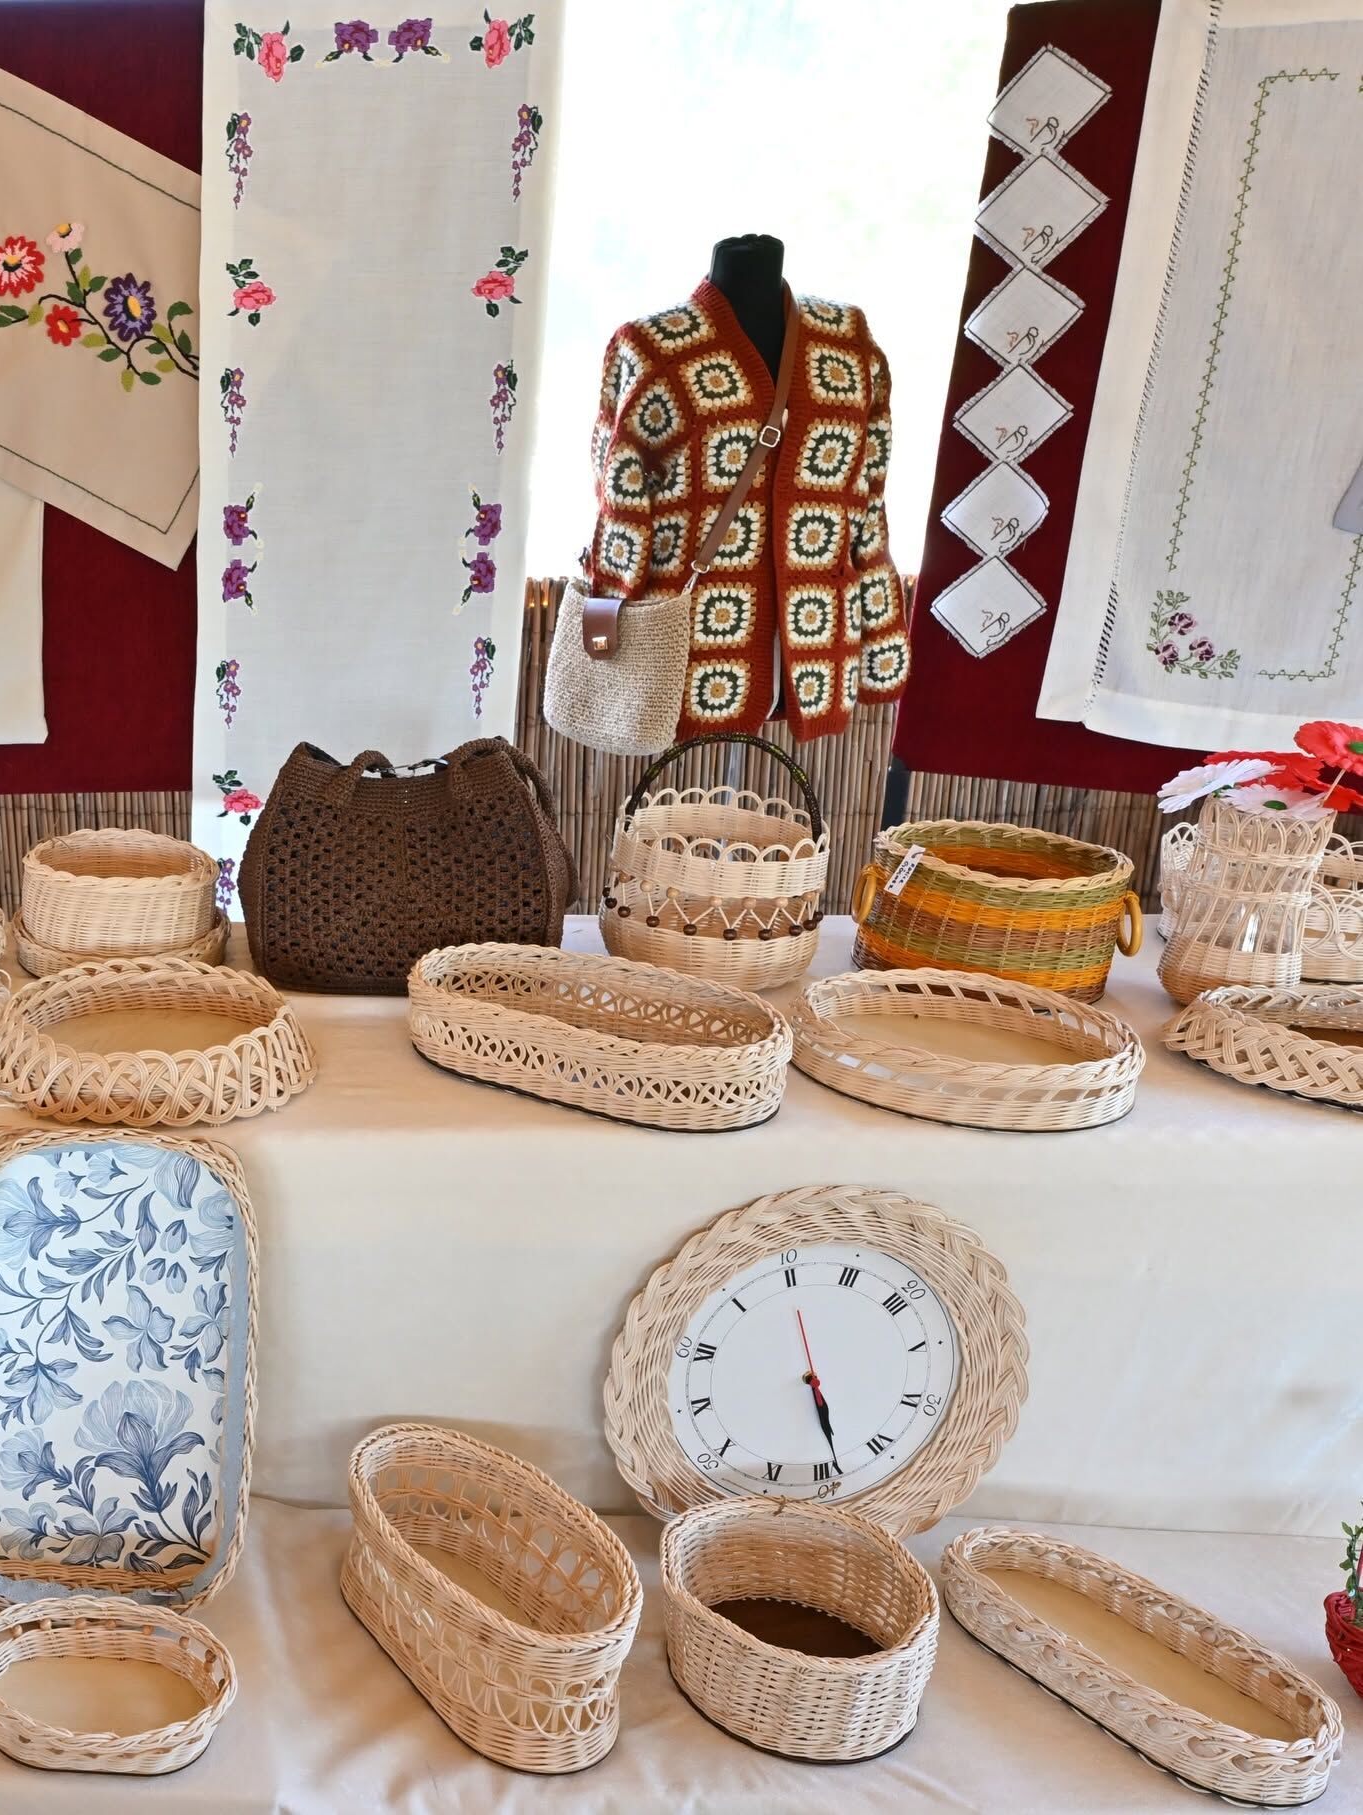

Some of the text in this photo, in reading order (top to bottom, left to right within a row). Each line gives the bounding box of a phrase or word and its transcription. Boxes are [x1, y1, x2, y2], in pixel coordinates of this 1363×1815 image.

[781, 1249, 797, 1265] 10
[838, 1267, 860, 1288] III
[901, 1280, 926, 1300] 20
[675, 1336, 693, 1358] 60
[923, 1394, 941, 1416] 30
[866, 1434, 893, 1455] VII
[697, 1453, 719, 1470] 50
[818, 1482, 841, 1498] 40
